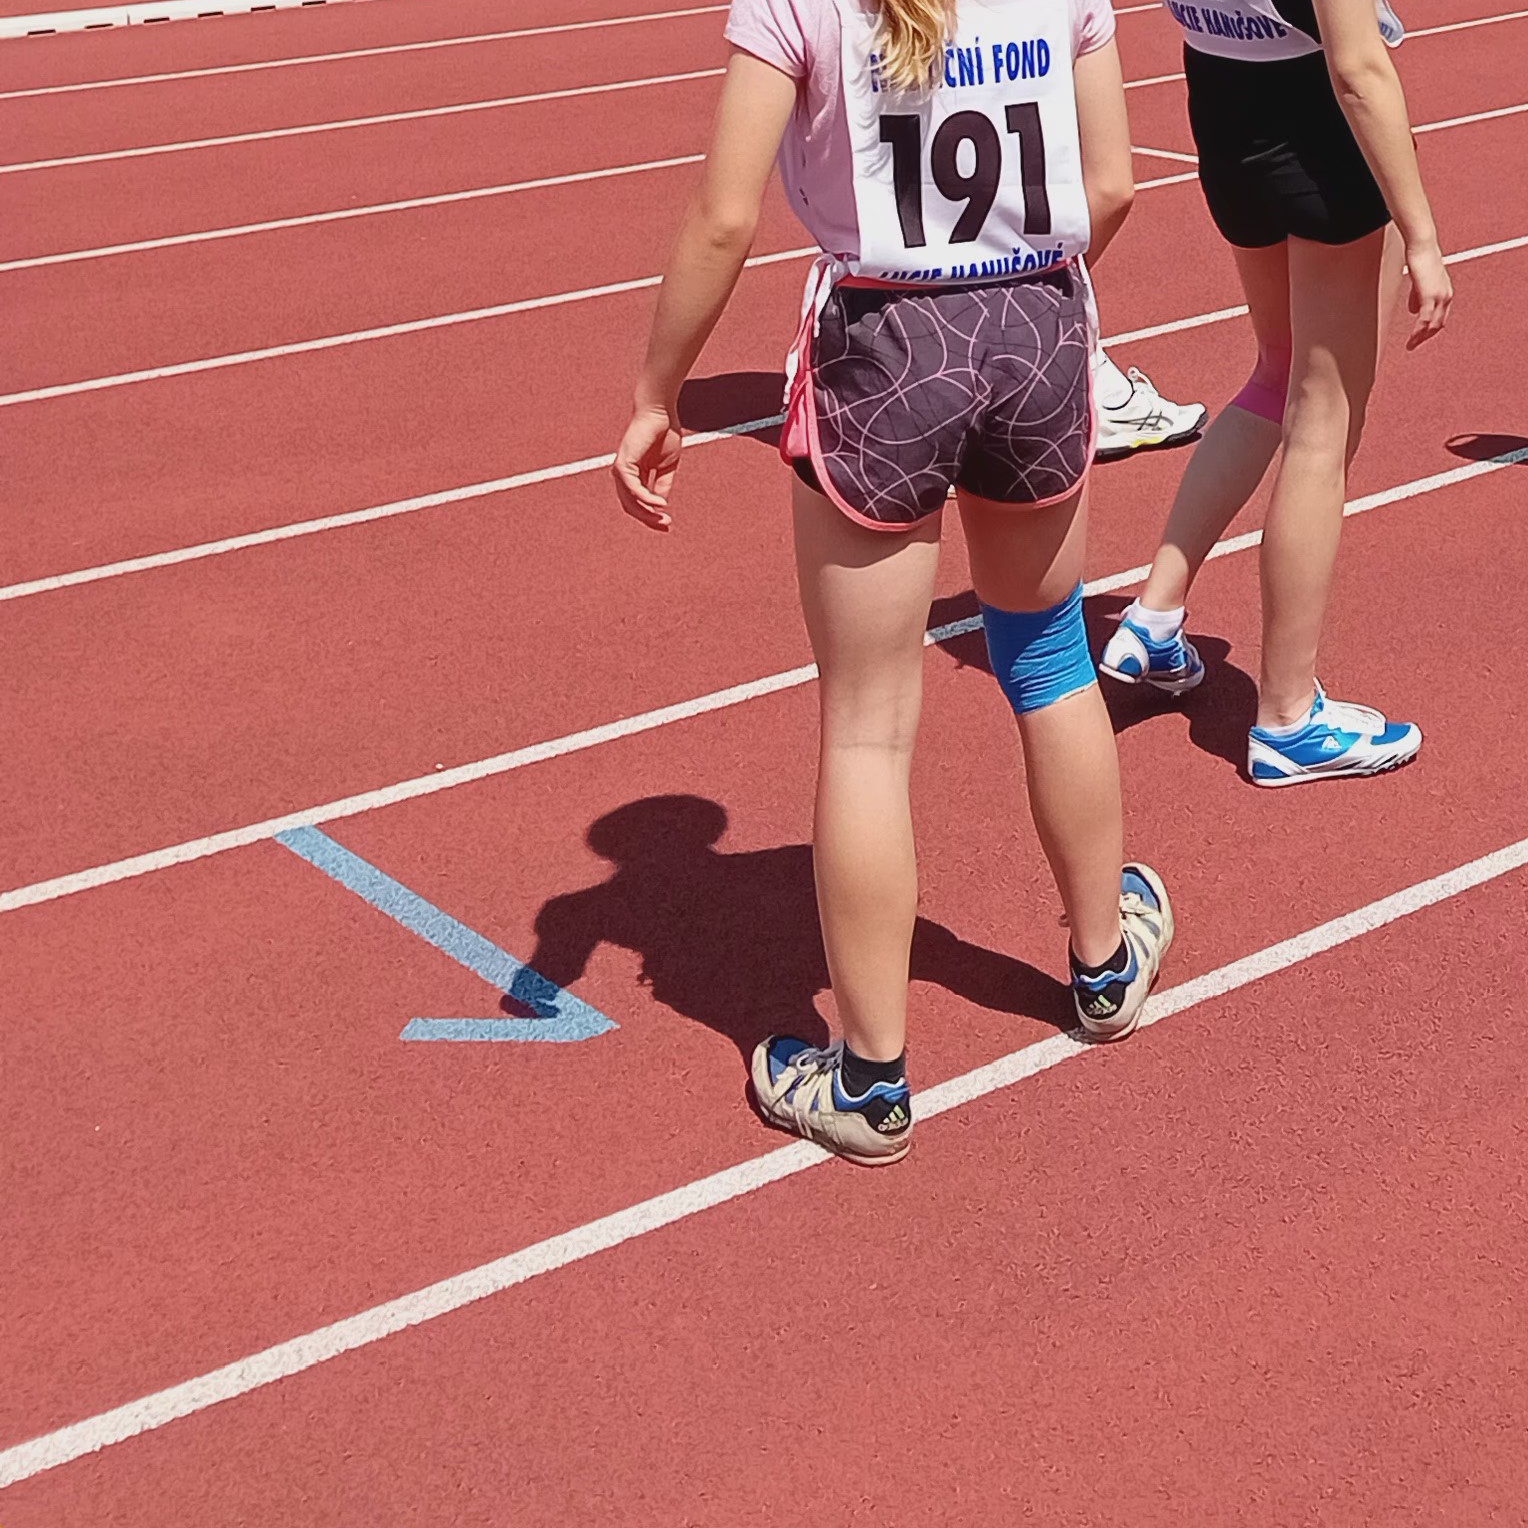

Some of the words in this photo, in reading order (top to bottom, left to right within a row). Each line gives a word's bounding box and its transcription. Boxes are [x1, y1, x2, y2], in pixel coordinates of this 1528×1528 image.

[870, 36, 984, 92] NČNÍ
[992, 38, 1050, 83] FOND
[878, 101, 1051, 249] 191
